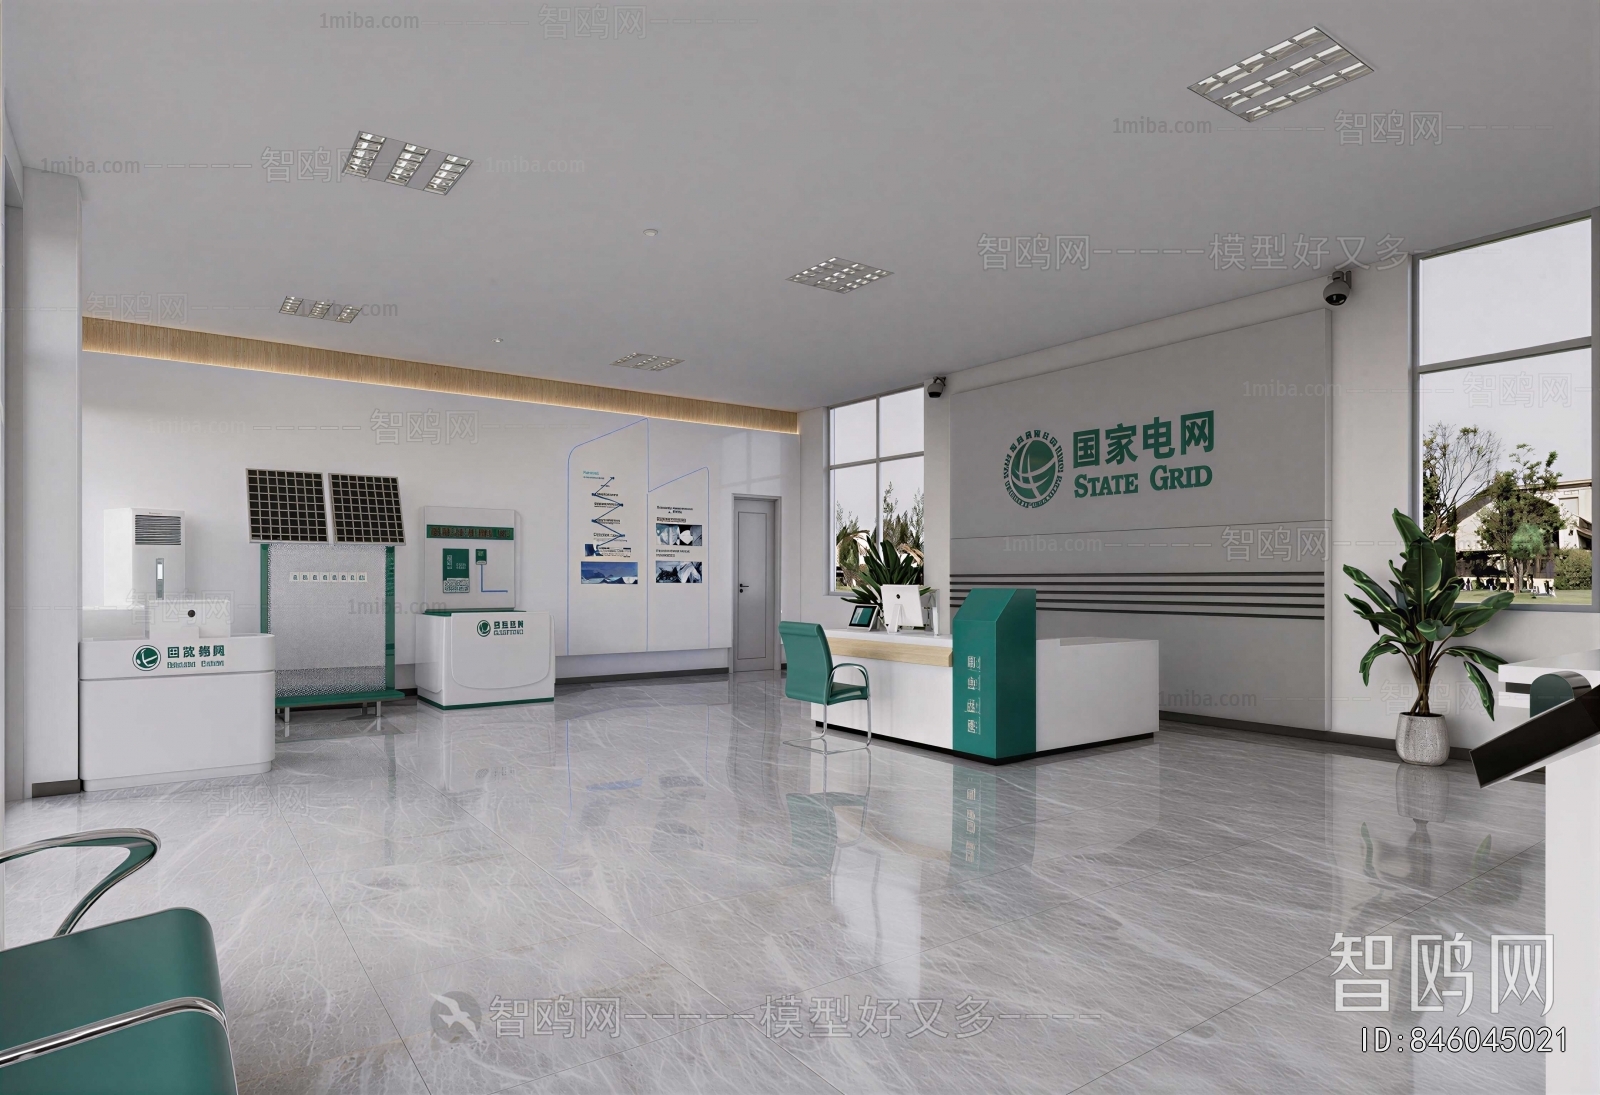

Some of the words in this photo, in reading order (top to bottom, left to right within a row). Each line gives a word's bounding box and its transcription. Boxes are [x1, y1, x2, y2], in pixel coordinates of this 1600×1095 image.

[1073, 410, 1214, 468] 国家电网
[1074, 473, 1138, 498] STATE
[1150, 465, 1212, 491] GRID
